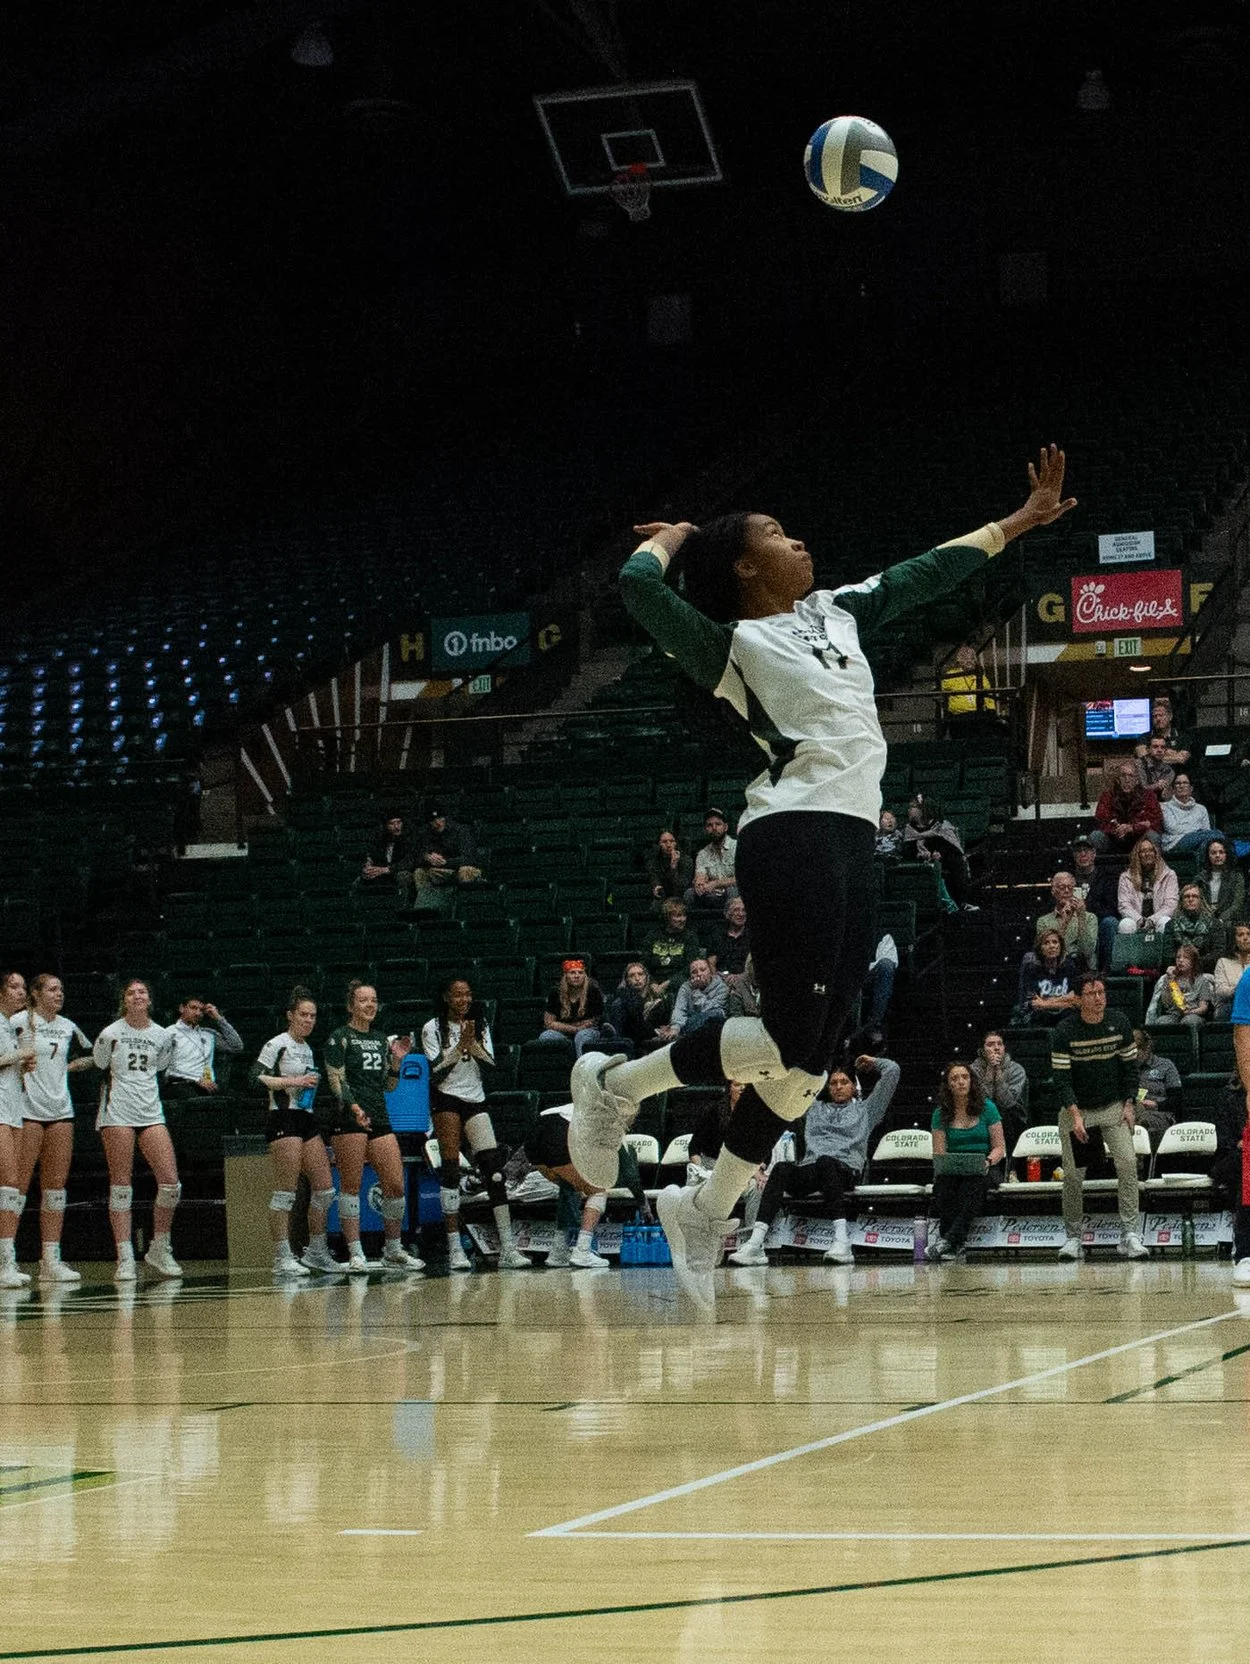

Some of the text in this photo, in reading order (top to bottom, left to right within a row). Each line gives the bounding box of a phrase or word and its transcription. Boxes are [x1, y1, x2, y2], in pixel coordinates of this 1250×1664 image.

[1037, 593, 1065, 622] G
[1076, 592, 1178, 623] Chick-fil-A
[1190, 582, 1214, 613] F
[400, 632, 424, 661] H
[470, 630, 518, 652] fnbo
[1118, 639, 1138, 655] EXIT
[49, 1042, 58, 1059] 7
[128, 1053, 148, 1072] 23
[362, 1052, 382, 1070] 22
[1002, 1218, 1063, 1233] Pedersen
